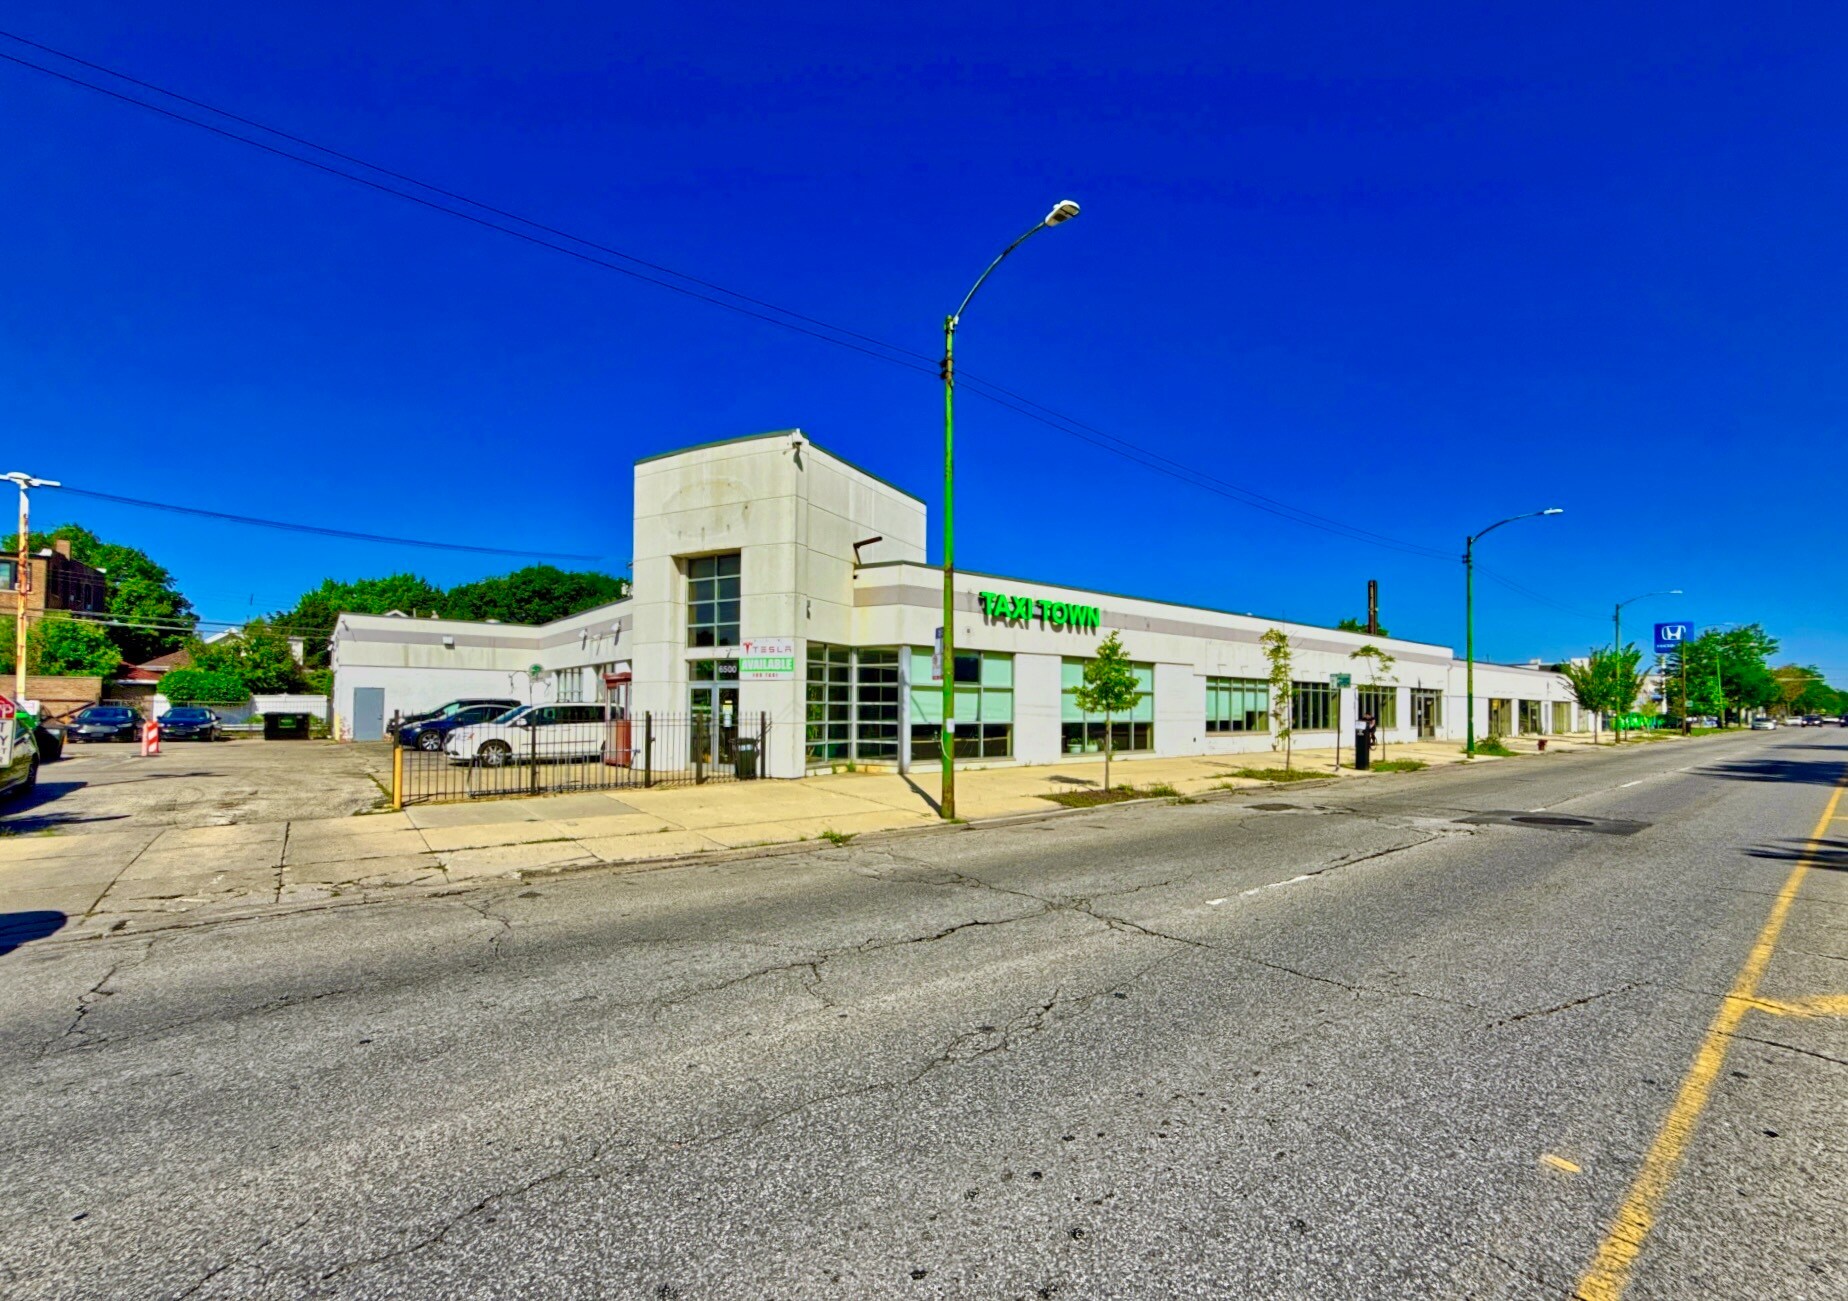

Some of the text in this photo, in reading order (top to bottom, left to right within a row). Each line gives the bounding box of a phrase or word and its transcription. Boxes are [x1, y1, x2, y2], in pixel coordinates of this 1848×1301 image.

[979, 592, 1100, 627] TAXI TOWN
[719, 665, 737, 673] 6500
[741, 658, 793, 670] AVAILABLE
